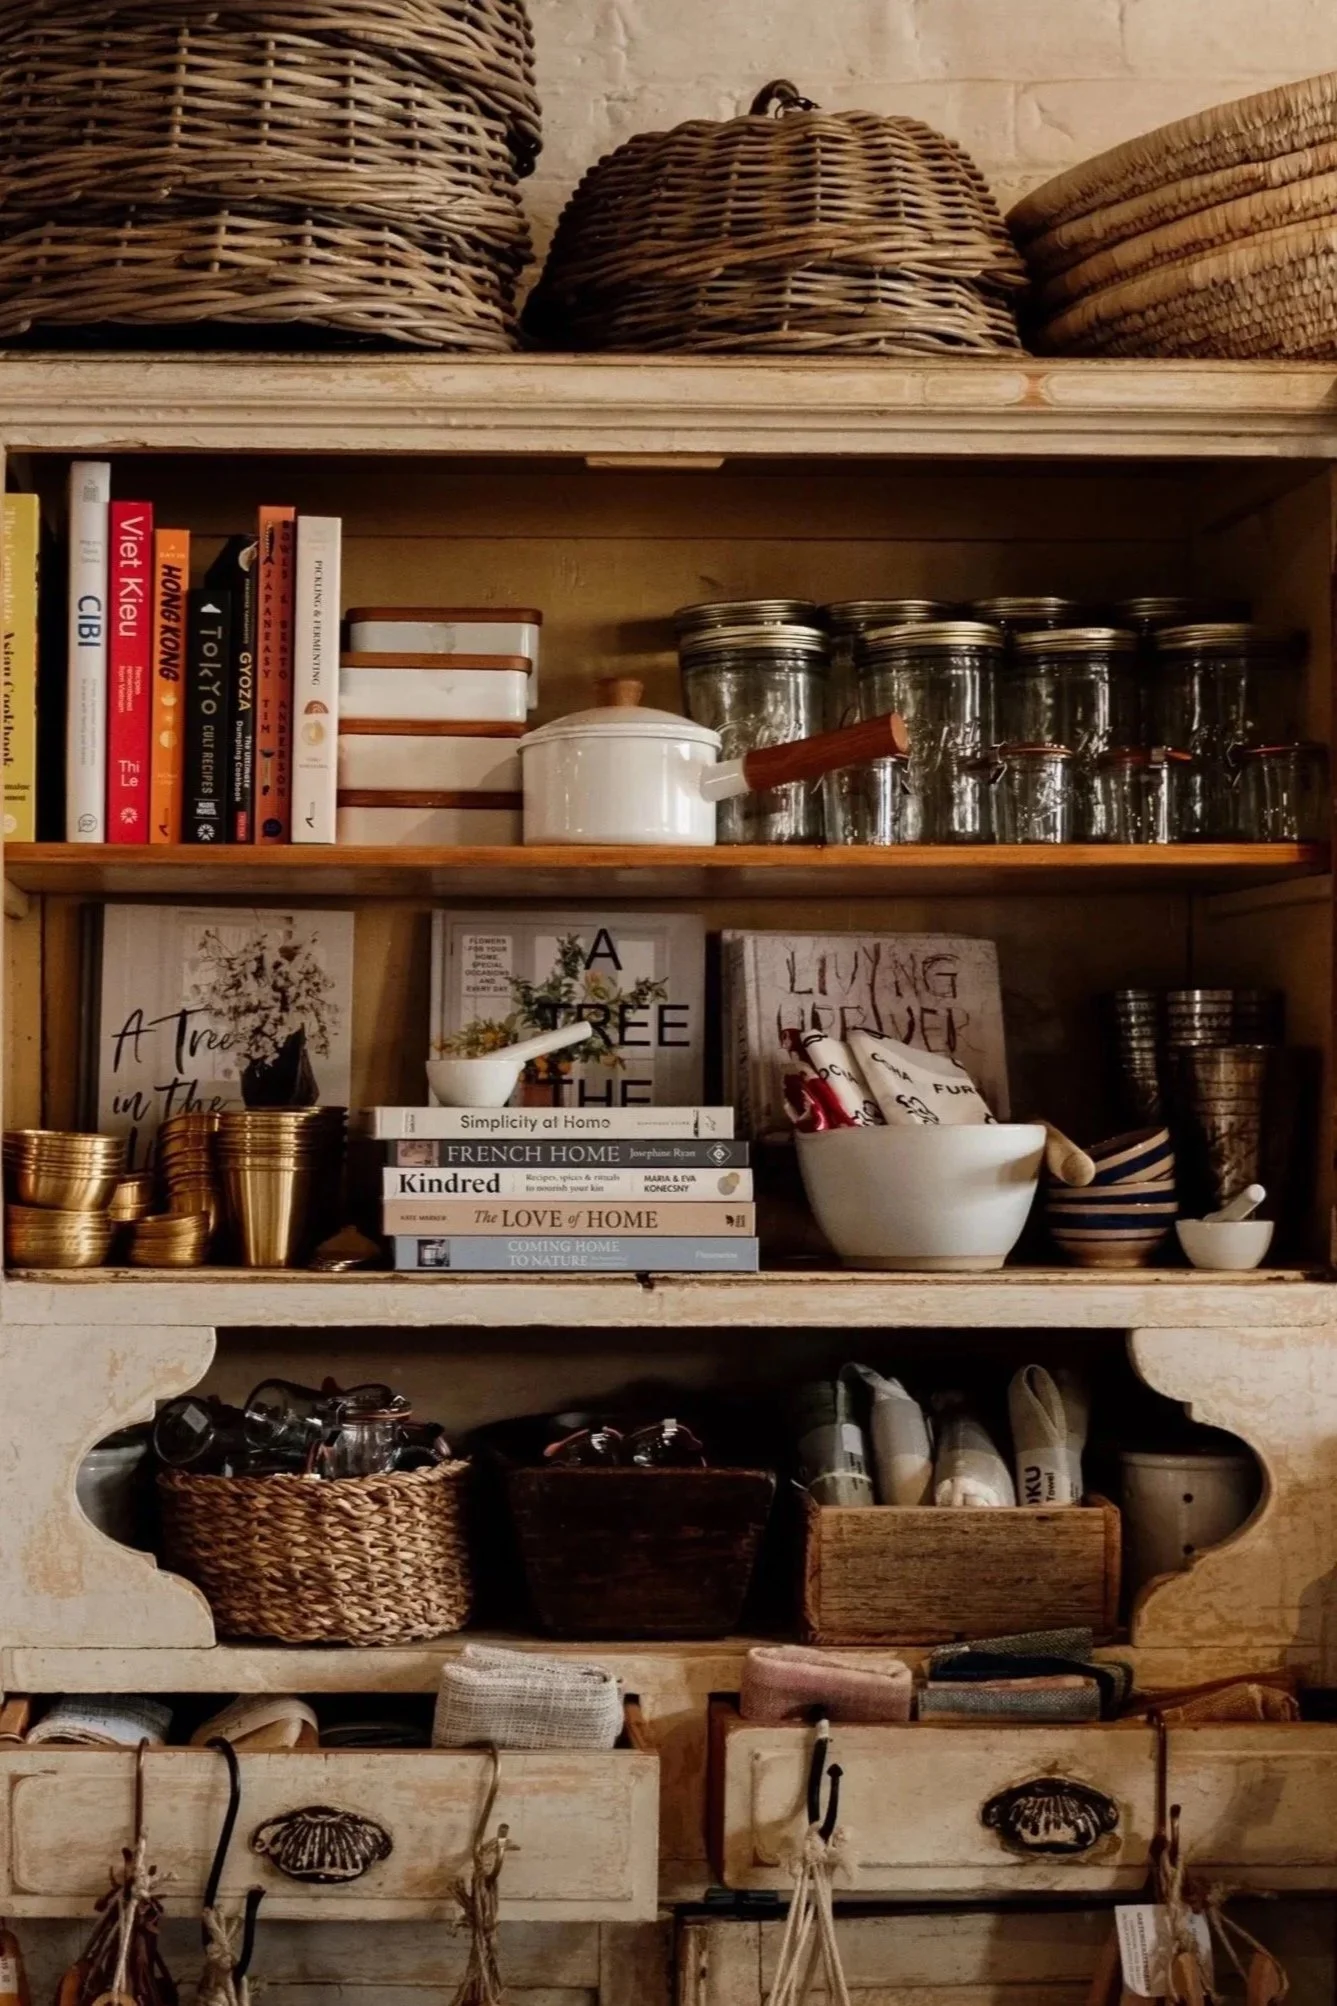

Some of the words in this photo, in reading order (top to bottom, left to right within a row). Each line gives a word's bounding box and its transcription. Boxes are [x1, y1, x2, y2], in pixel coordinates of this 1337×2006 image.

[119, 516, 144, 568] Viet
[160, 563, 182, 623] HONG
[313, 560, 323, 607] PICKLING
[78, 595, 101, 647] CIBI
[119, 577, 144, 637] Kieu
[262, 569, 273, 678] JAPANEASY
[312, 609, 322, 617] &
[158, 624, 181, 682] KONG
[278, 620, 288, 680] BENTO
[311, 620, 322, 686] FERMENTING
[118, 684, 126, 713] Vietnam
[126, 666, 134, 712] remembered
[134, 666, 143, 695] Recipes
[238, 652, 252, 711] GYOZA
[260, 699, 272, 734] TIM
[202, 725, 215, 748] CULT
[234, 720, 244, 760] Dumpling
[276, 701, 287, 797] ANDERSON
[118, 760, 140, 773] Thi
[121, 774, 139, 788] Le
[201, 751, 215, 794] RECIPES
[233, 762, 243, 802] Cookbook
[243, 751, 252, 788] Ultimate
[583, 928, 622, 971] A
[786, 942, 962, 1000] LIVING
[111, 1008, 156, 1073] A
[148, 1004, 240, 1075] Tree
[538, 1003, 691, 1047] TREE
[113, 1089, 151, 1122] in
[460, 1114, 538, 1133] Simplicity
[542, 1114, 559, 1129] at
[564, 1114, 612, 1129] Home
[447, 1145, 543, 1163] FRENCH
[549, 1145, 621, 1163] HOME
[629, 1147, 671, 1161] Josephine
[673, 1147, 697, 1161] Ryan
[399, 1173, 502, 1194] Kindred
[525, 1184, 535, 1192] to
[536, 1184, 568, 1192] nourish
[570, 1185, 589, 1194] your
[591, 1184, 604, 1192] kin
[584, 1173, 592, 1182] &
[594, 1173, 621, 1182] rituals
[643, 1174, 671, 1183] MARIA
[673, 1174, 680, 1183] &
[681, 1174, 697, 1183] EVA
[643, 1184, 689, 1193] KONECSNY
[474, 1210, 498, 1224] The
[502, 1210, 563, 1228] LOVE
[567, 1211, 583, 1229] of
[587, 1210, 659, 1229] HOME
[507, 1240, 572, 1252] COMING
[575, 1240, 621, 1252] HOME
[509, 1255, 529, 1267] TO
[531, 1255, 588, 1268] NATURE
[1044, 1472, 1056, 1502] Towel
